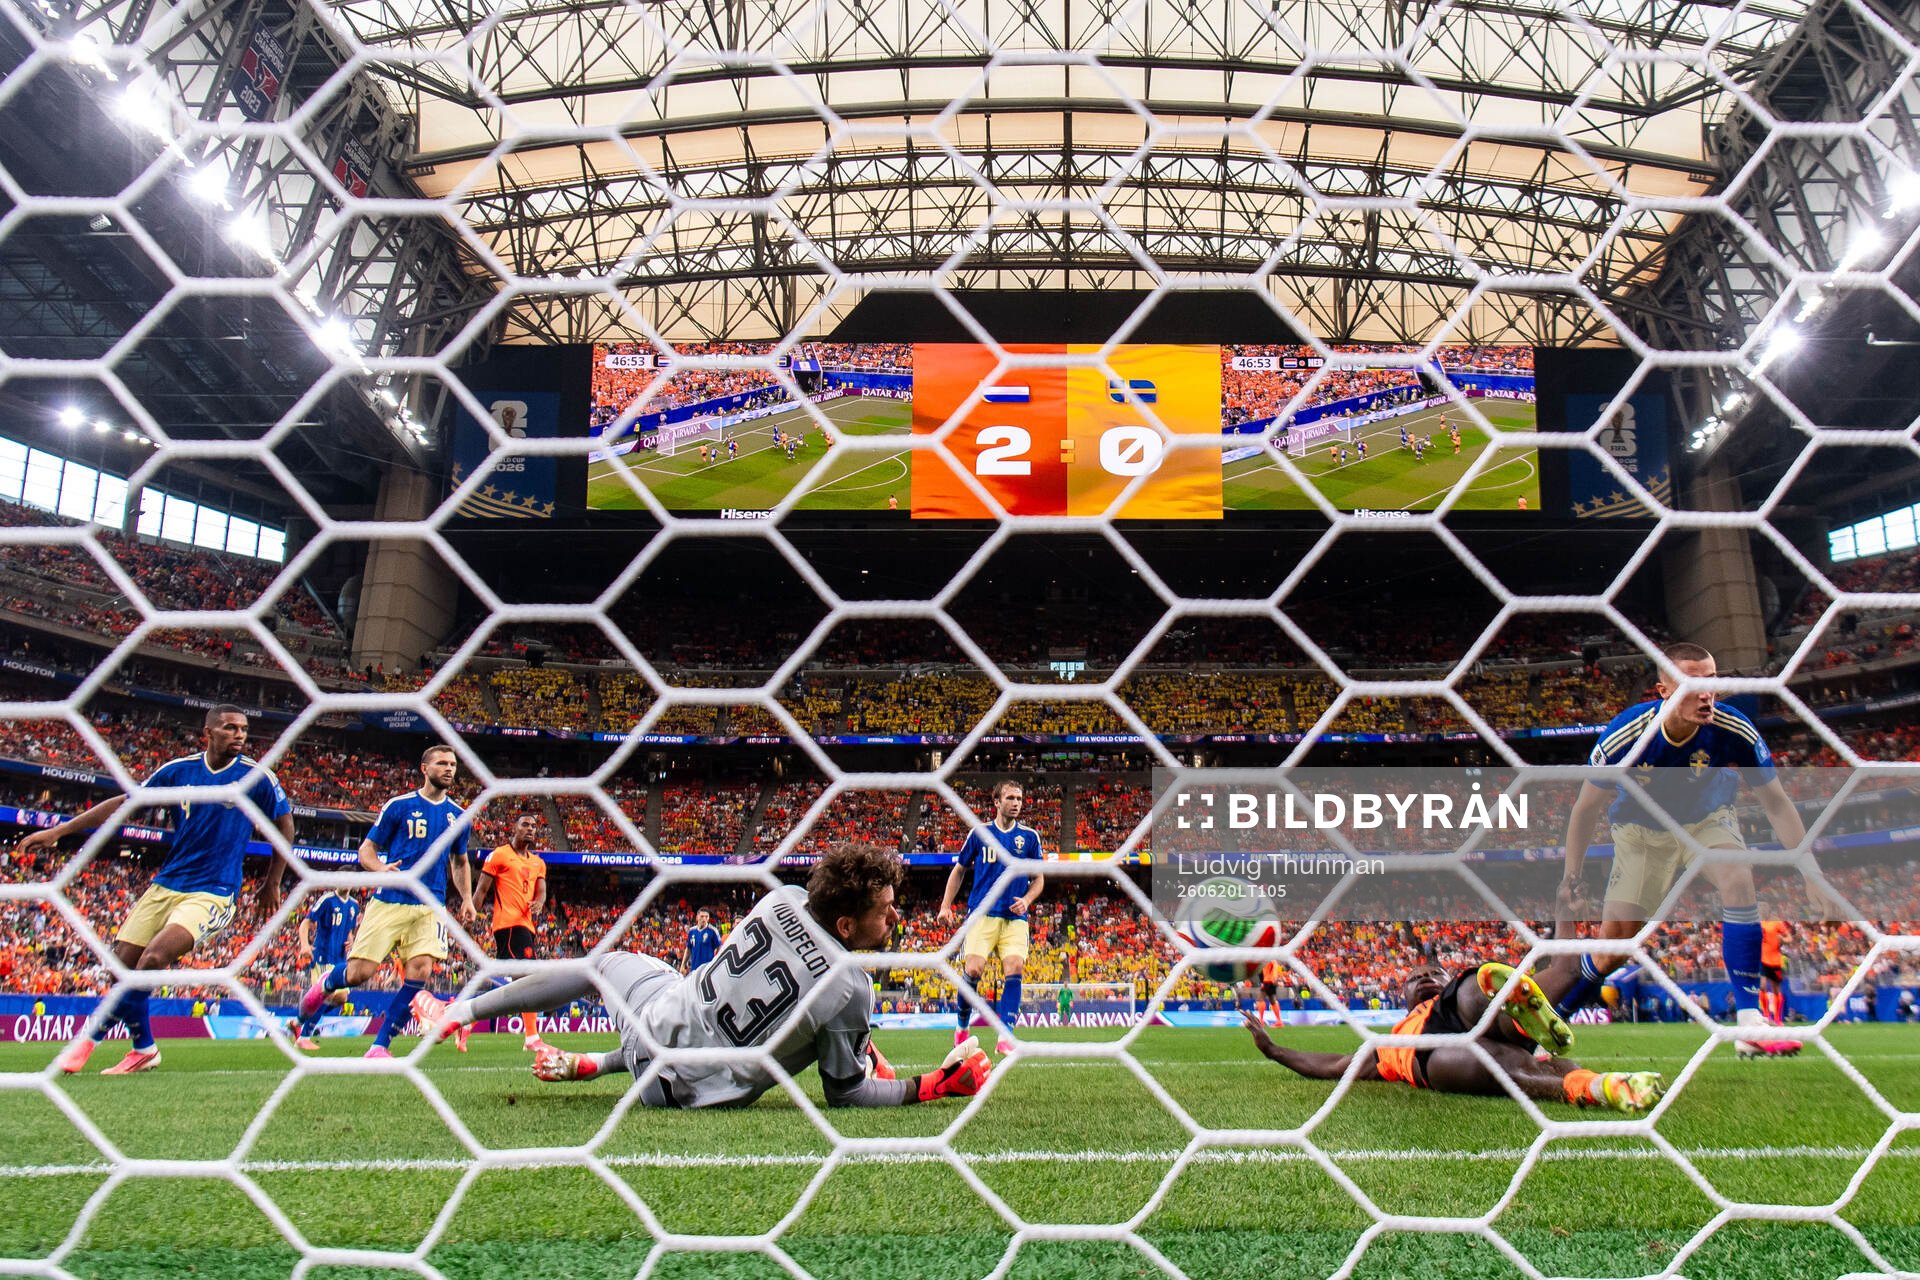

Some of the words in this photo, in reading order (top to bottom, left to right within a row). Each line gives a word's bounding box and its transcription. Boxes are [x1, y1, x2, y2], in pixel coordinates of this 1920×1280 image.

[255, 32, 284, 73] CHAMPIONS
[240, 84, 260, 113] 2023
[344, 142, 372, 176] CHAMPIONS
[612, 356, 645, 367] 46:53
[1238, 358, 1271, 368] 46:53
[862, 388, 892, 398] QATAR
[1484, 389, 1516, 399] QATAR
[1428, 395, 1447, 408] QATAR
[643, 432, 670, 448] QATAR
[1274, 433, 1300, 449] QATAR
[976, 426, 1031, 475] 2
[1100, 426, 1163, 477] 0
[1610, 444, 1627, 452] FIFA
[721, 508, 778, 519] Hisense
[1354, 508, 1410, 519] Hisense
[3, 660, 56, 678] HOUSTON
[502, 728, 538, 736] HOUSTON
[1540, 728, 1556, 736] FIFA
[1556, 728, 1580, 736] WORLD
[1580, 726, 1594, 734] CUP
[604, 734, 619, 742] FIFA
[42, 766, 96, 784] HOUSTON
[293, 807, 317, 817] 2026
[122, 827, 162, 840] HOUSTON
[406, 819, 428, 839] 16
[293, 848, 310, 859] FIFA
[310, 848, 340, 861] WORLD
[340, 852, 358, 862] CUP
[582, 854, 600, 864] FIFA
[601, 855, 632, 864] WORLD
[634, 856, 652, 864] CUP
[982, 846, 997, 864] 10
[700, 916, 800, 1048] 23
[1068, 1011, 1144, 1028] AIRWAYS
[14, 1014, 75, 1043] QATAR
